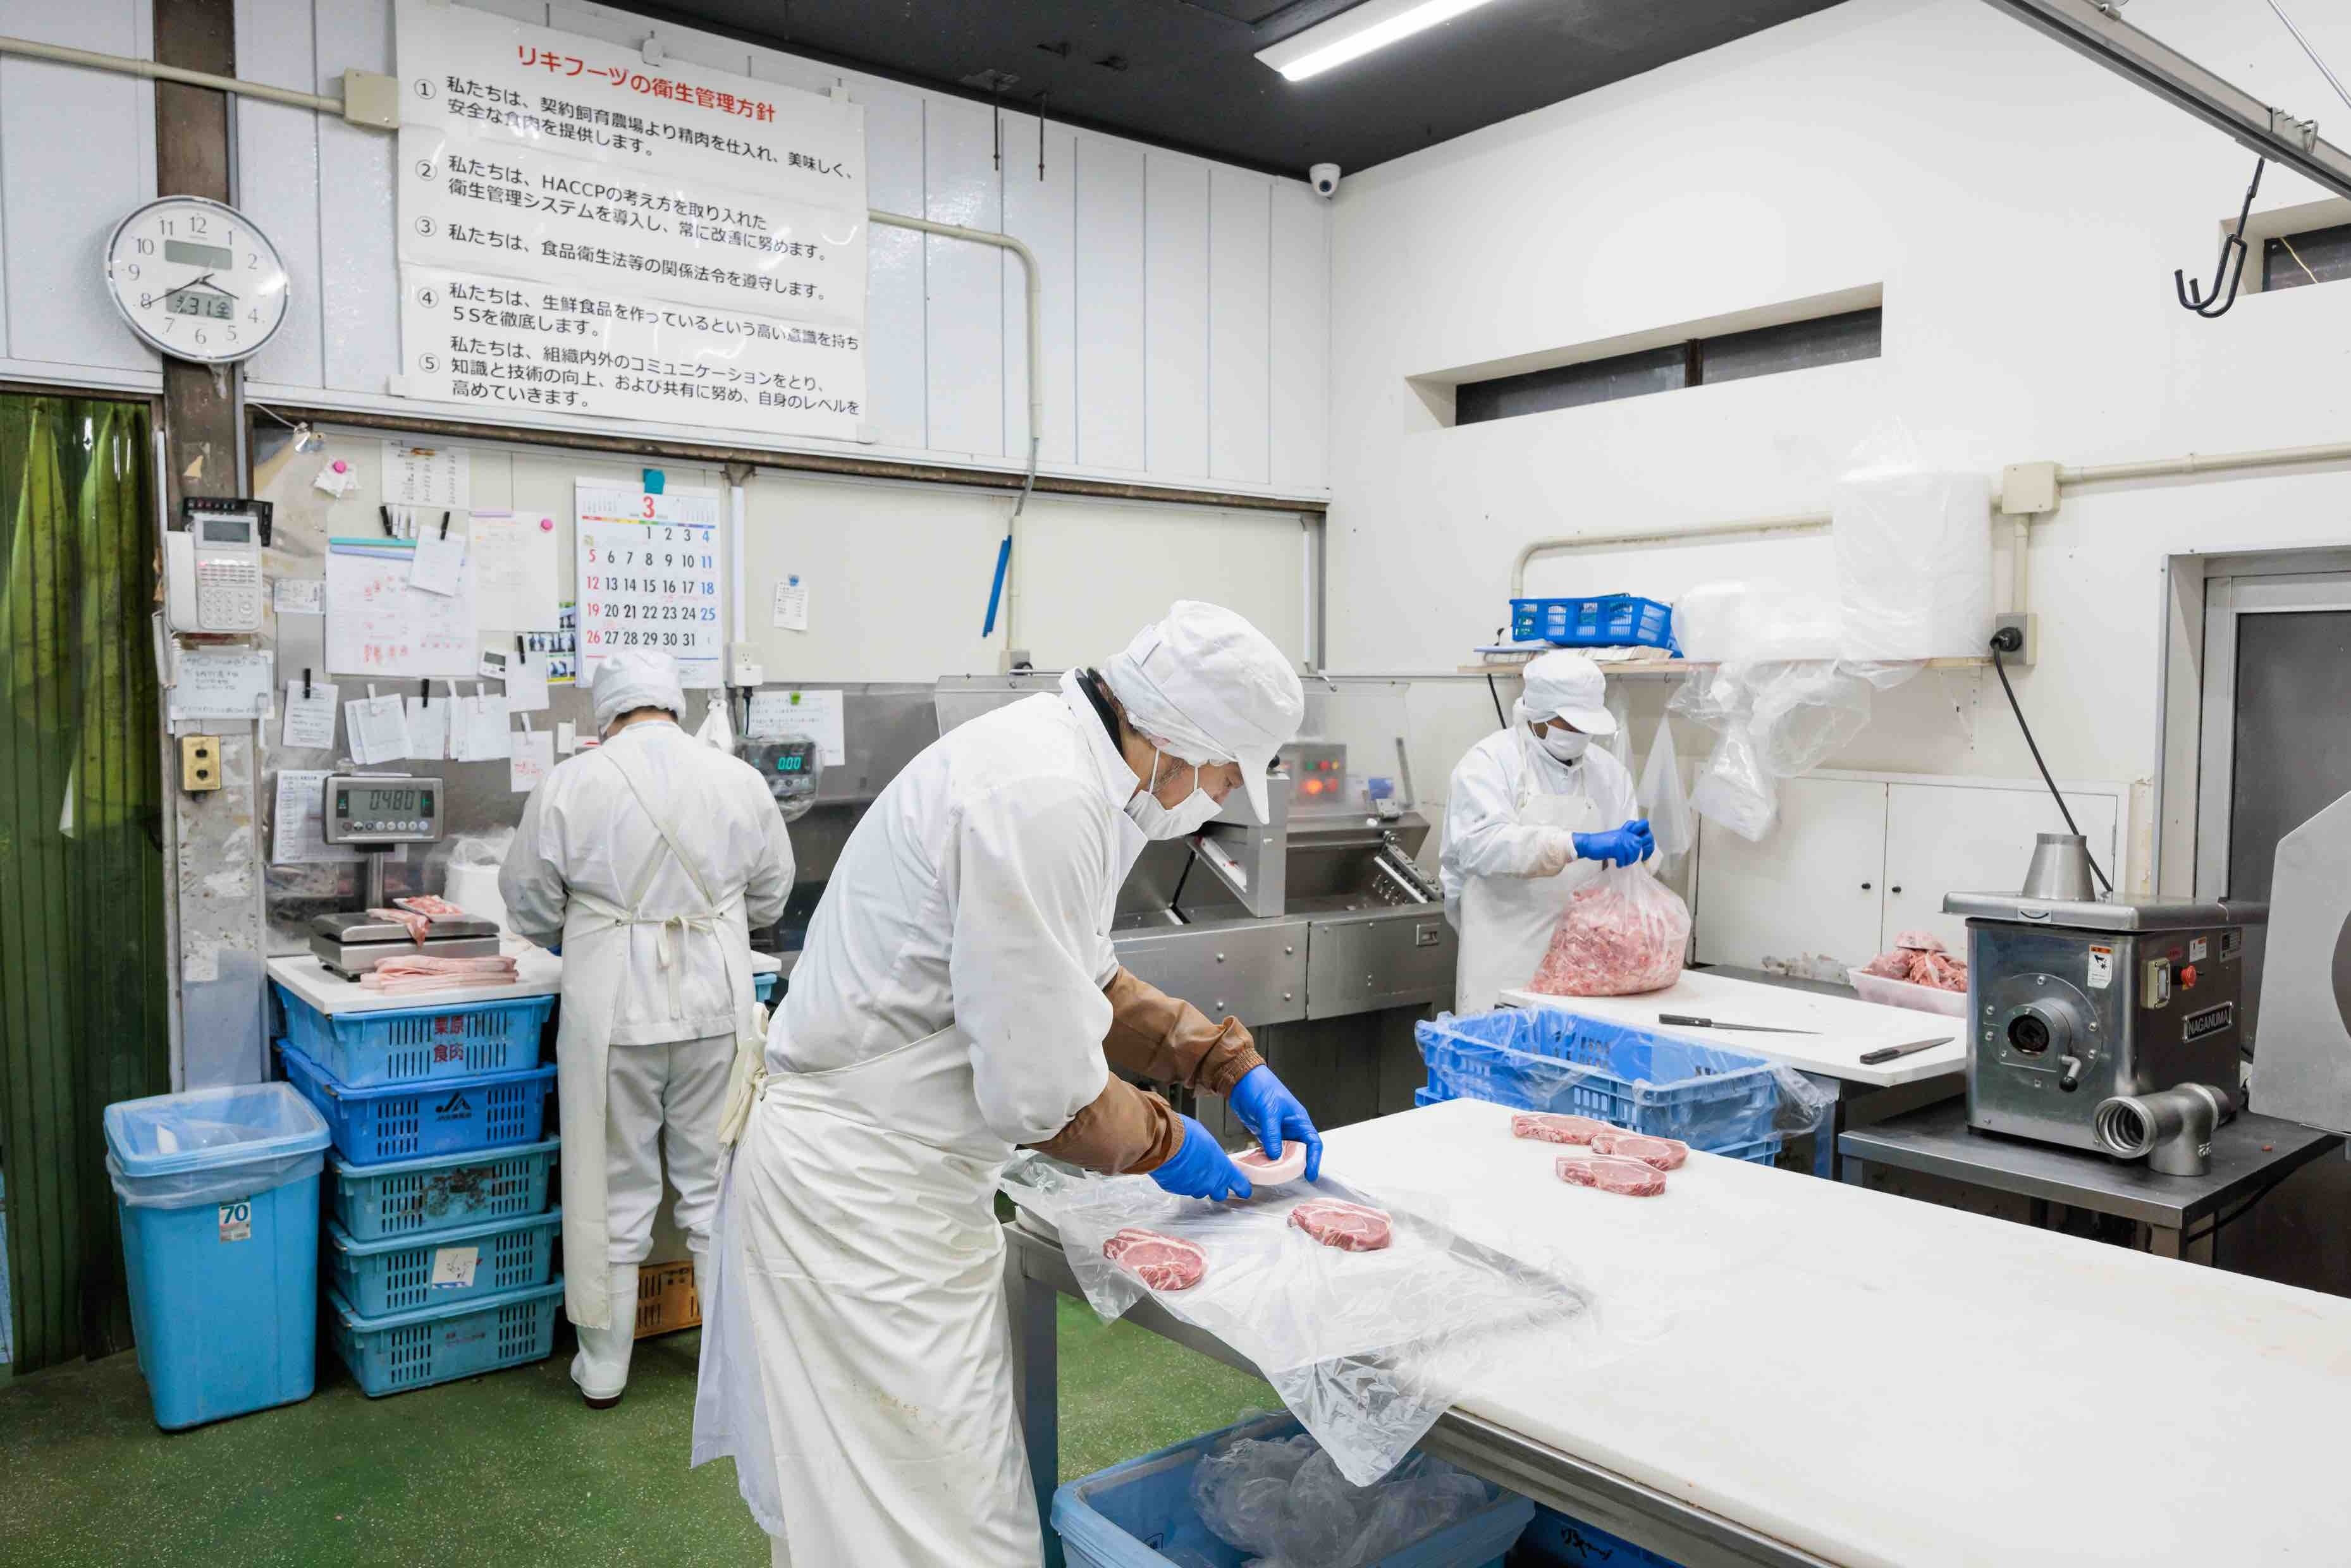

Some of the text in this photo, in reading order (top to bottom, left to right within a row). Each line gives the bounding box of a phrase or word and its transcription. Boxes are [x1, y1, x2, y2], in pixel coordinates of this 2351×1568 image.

[448, 155, 767, 230] 私たちは、HACCPの考え方を取り入れた
[160, 220, 173, 236] 11
[190, 216, 207, 234] 12
[137, 238, 154, 255] 10
[228, 230, 232, 246] 1
[247, 254, 258, 270] 2
[448, 223, 824, 300] 私たちは、食品衛生法等の関係法令を遵守します。
[128, 264, 140, 281] 9
[247, 308, 258, 323] 4
[164, 317, 175, 334] 7
[227, 325, 237, 341] 5
[195, 328, 207, 344] 6
[450, 336, 823, 393] 私たちは、組織内外のコミュニケーションをとり、
[451, 357, 859, 415] 知識と技術の向上、および共有に努め、自身のレベルを
[452, 380, 588, 408] 高めていきます。
[642, 496, 654, 518] 3
[647, 526, 709, 543] 1 2 3 4
[589, 549, 711, 568] 5 6 7 8 9 10 11
[587, 576, 714, 595] 12 13 14 15 16 17 18
[587, 603, 716, 621] 19 20 21 22 23 24 25
[587, 630, 601, 644] 26
[605, 631, 618, 644] 27
[623, 632, 637, 645] 28
[642, 632, 658, 646] 29
[663, 633, 677, 646] 30
[682, 633, 695, 646] 31
[2187, 1009, 2228, 1036] NAGANUMA
[221, 1204, 248, 1224] 70
